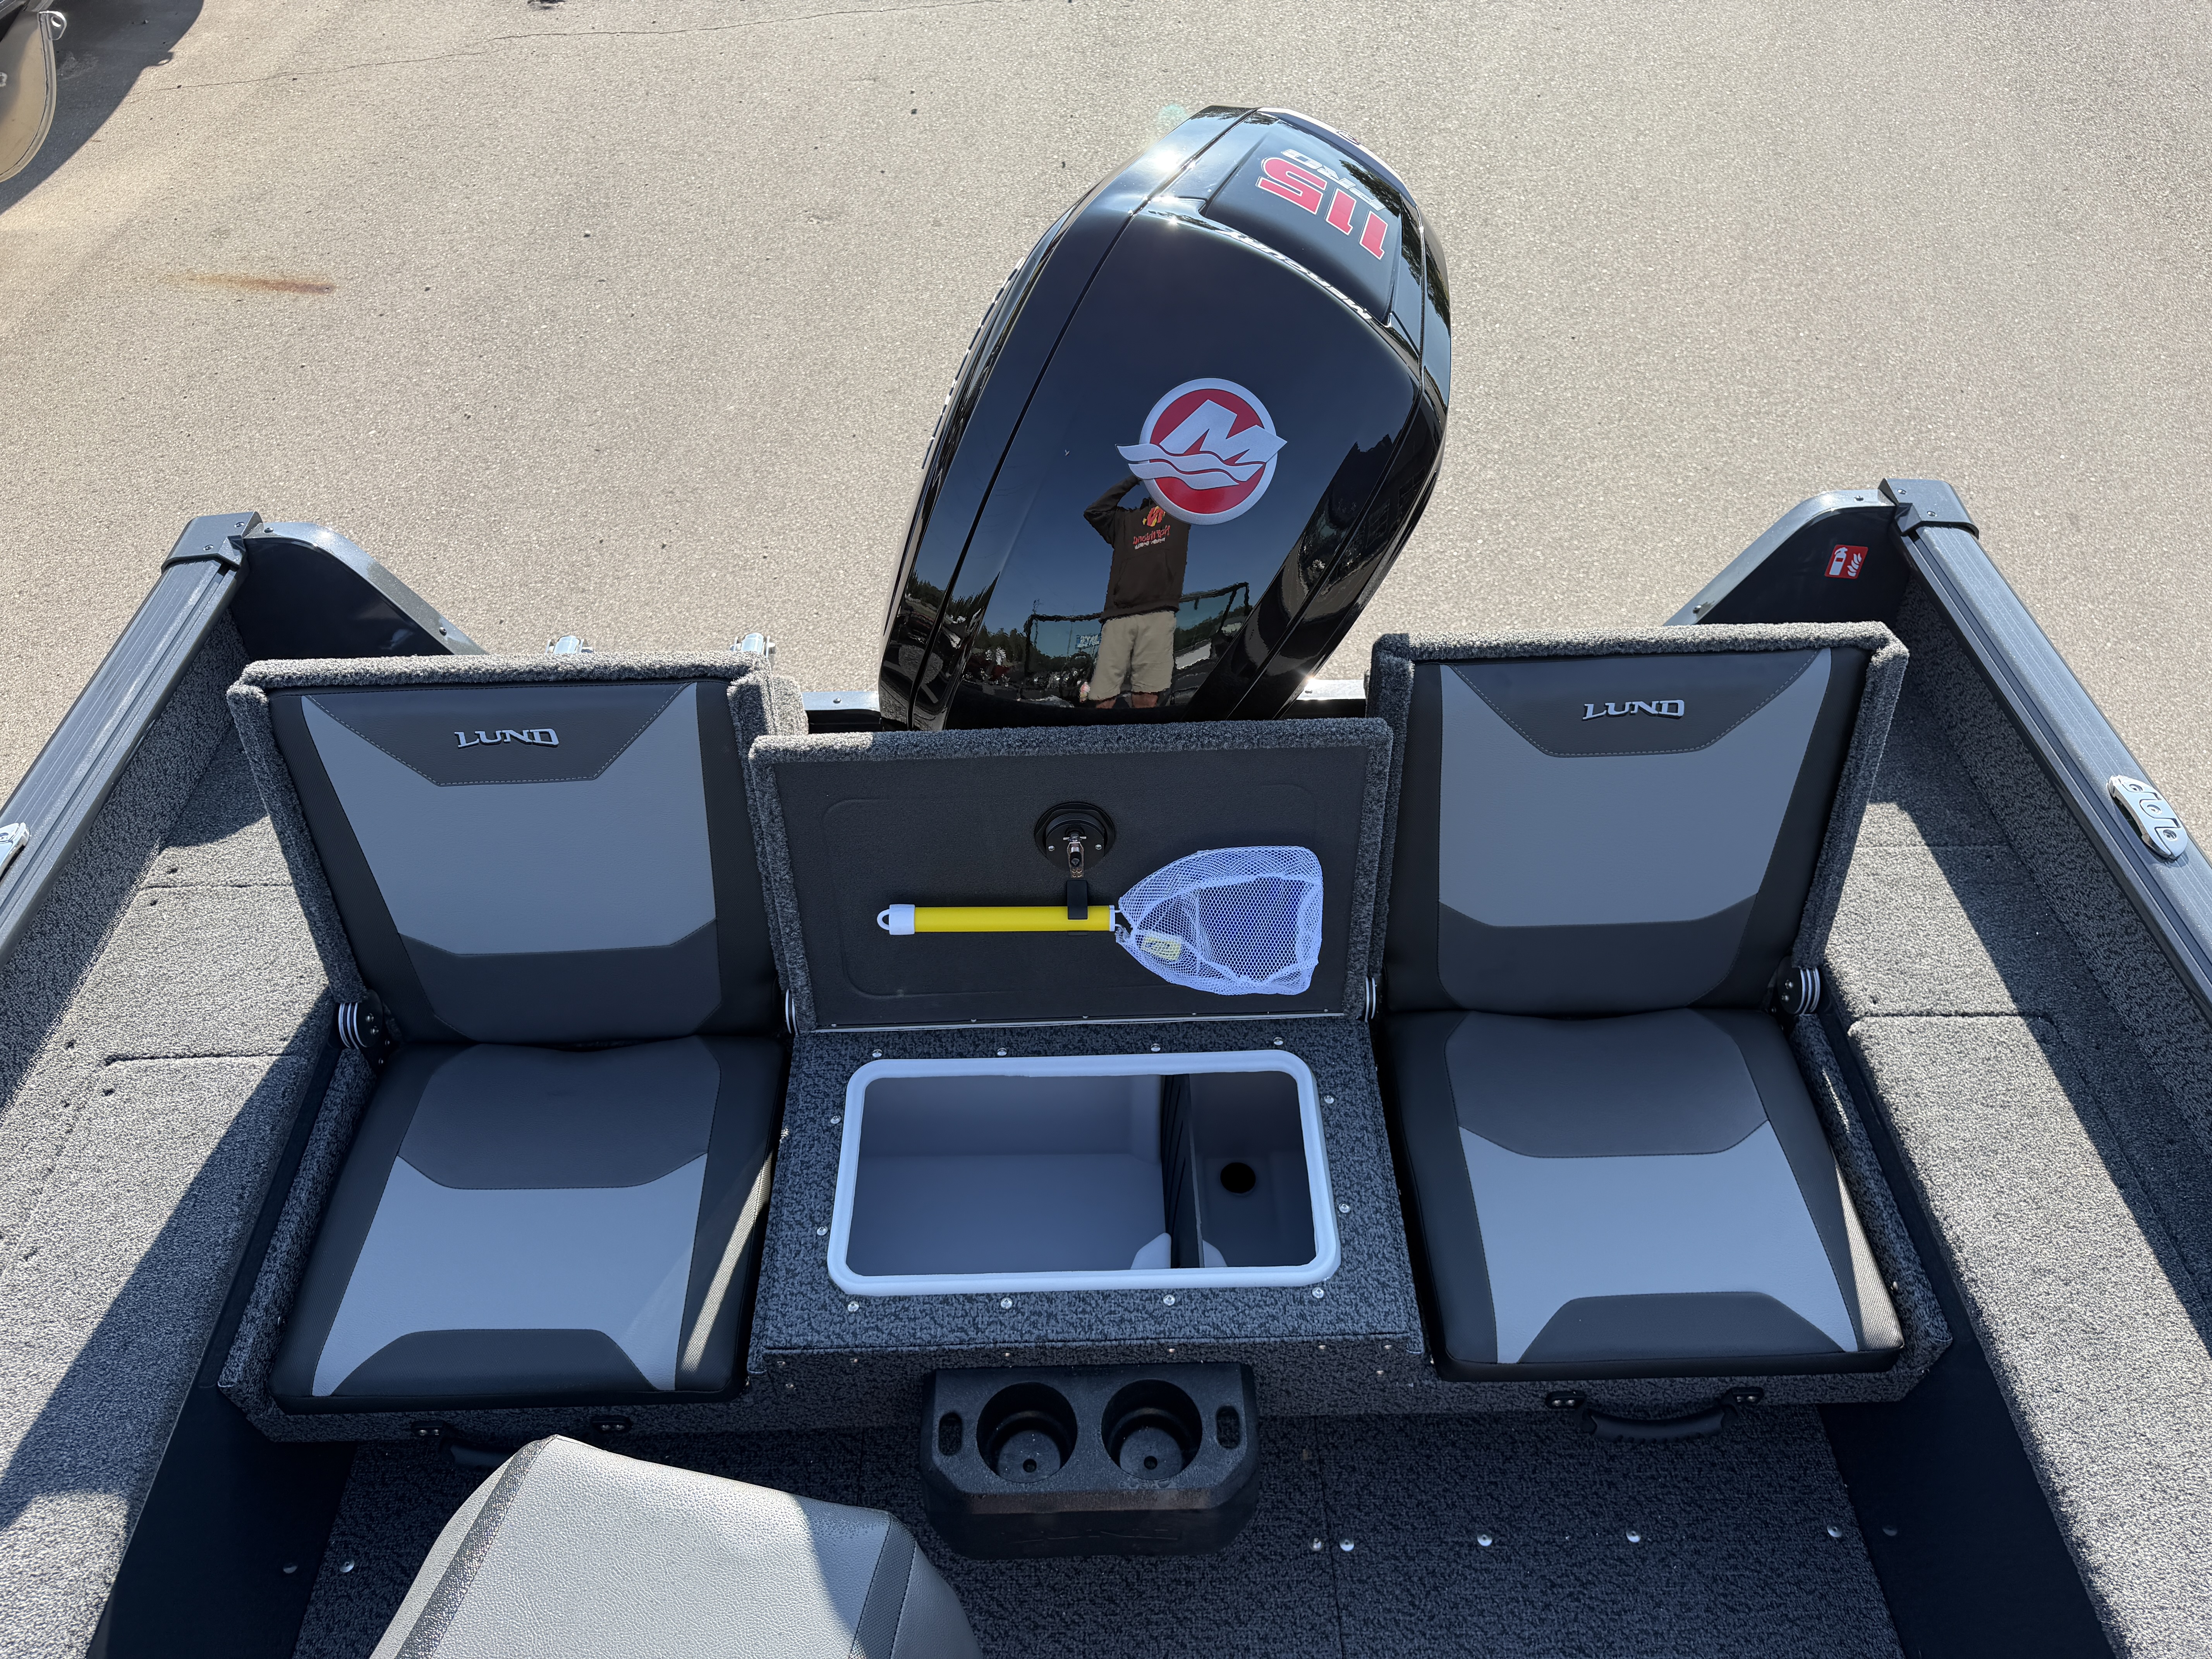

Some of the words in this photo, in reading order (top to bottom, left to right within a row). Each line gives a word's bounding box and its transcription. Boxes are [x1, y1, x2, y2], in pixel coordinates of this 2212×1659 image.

[1255, 157, 1388, 260] 115
[1281, 149, 1386, 211] PRO
[1214, 229, 1372, 319] MERCURY
[454, 728, 559, 748] LUND
[1582, 699, 1685, 720] LUND
